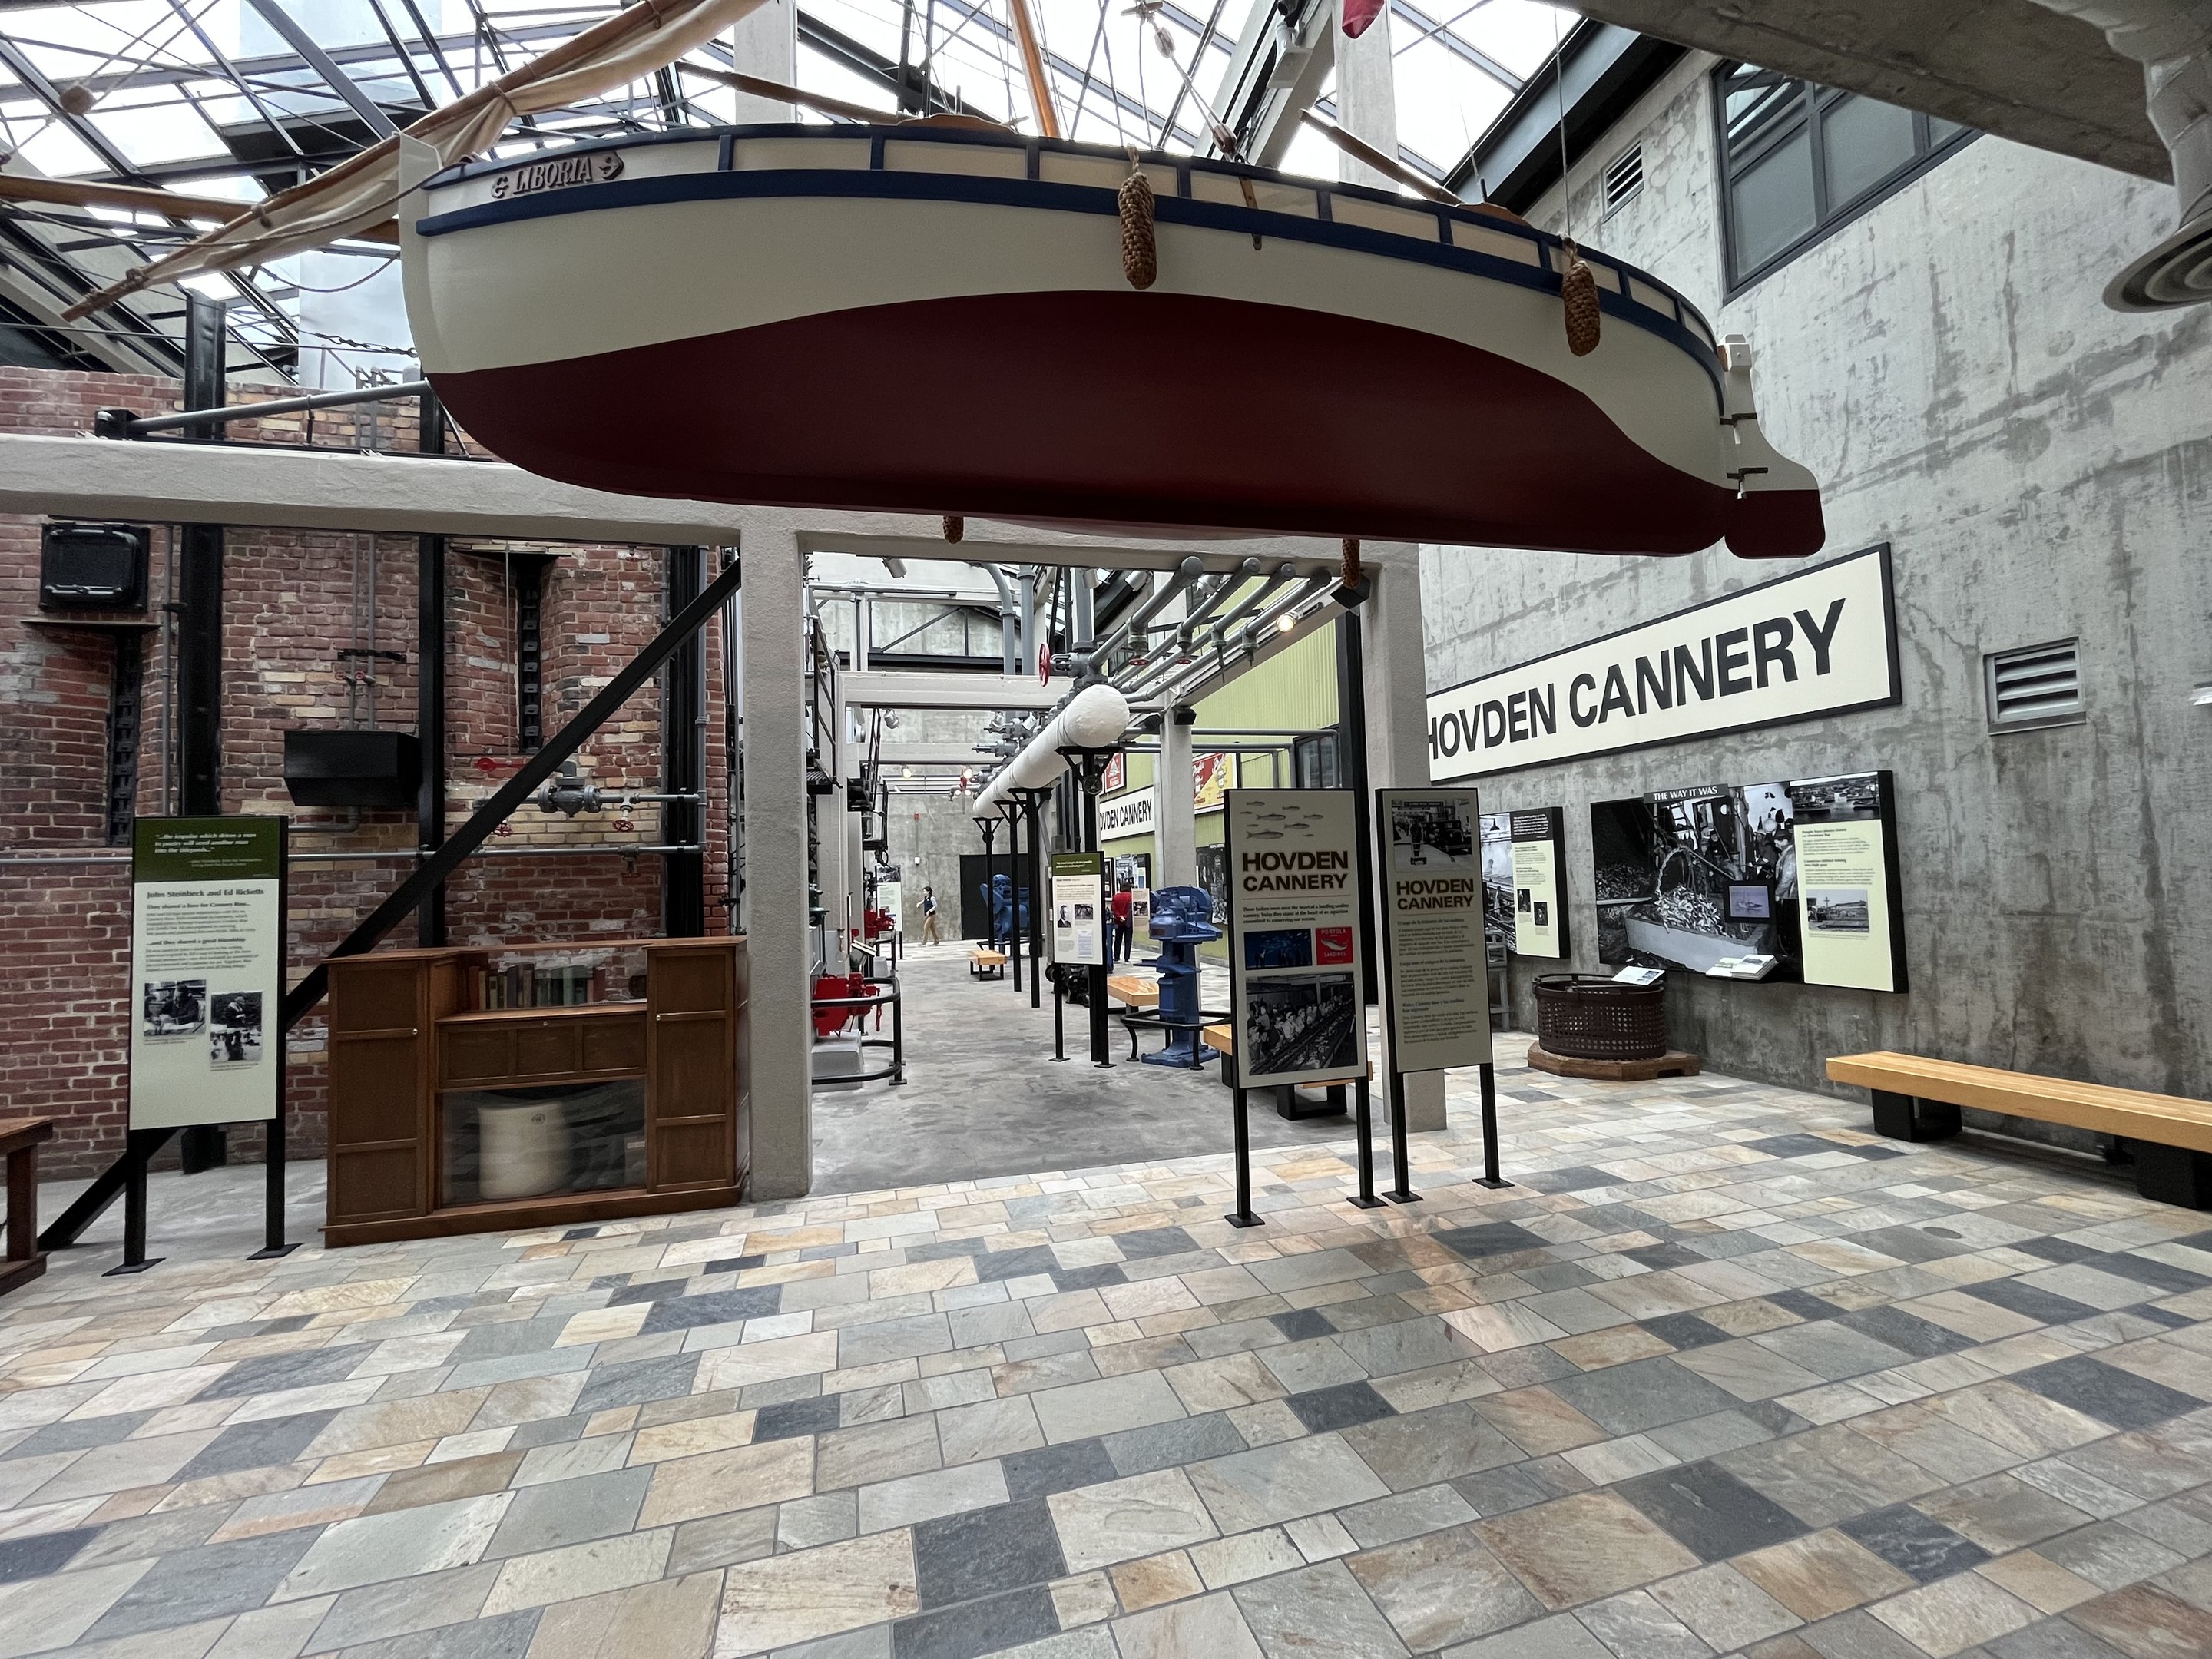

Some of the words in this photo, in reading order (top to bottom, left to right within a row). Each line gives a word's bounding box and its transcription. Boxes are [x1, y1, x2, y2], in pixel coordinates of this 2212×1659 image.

[513, 156, 593, 194] LIBORIA
[1569, 598, 1846, 728] CANNERY
[1653, 792, 1668, 800] THE
[1669, 789, 1687, 799] WAY
[1689, 788, 1697, 796] IT
[1698, 786, 1717, 795] WAS
[1120, 798, 1152, 827] CANNERY
[1242, 851, 1348, 871] HOVDEN
[1243, 873, 1348, 891] CANNERY
[1396, 879, 1474, 895] HOVDEN
[1397, 895, 1474, 910] CANNERY
